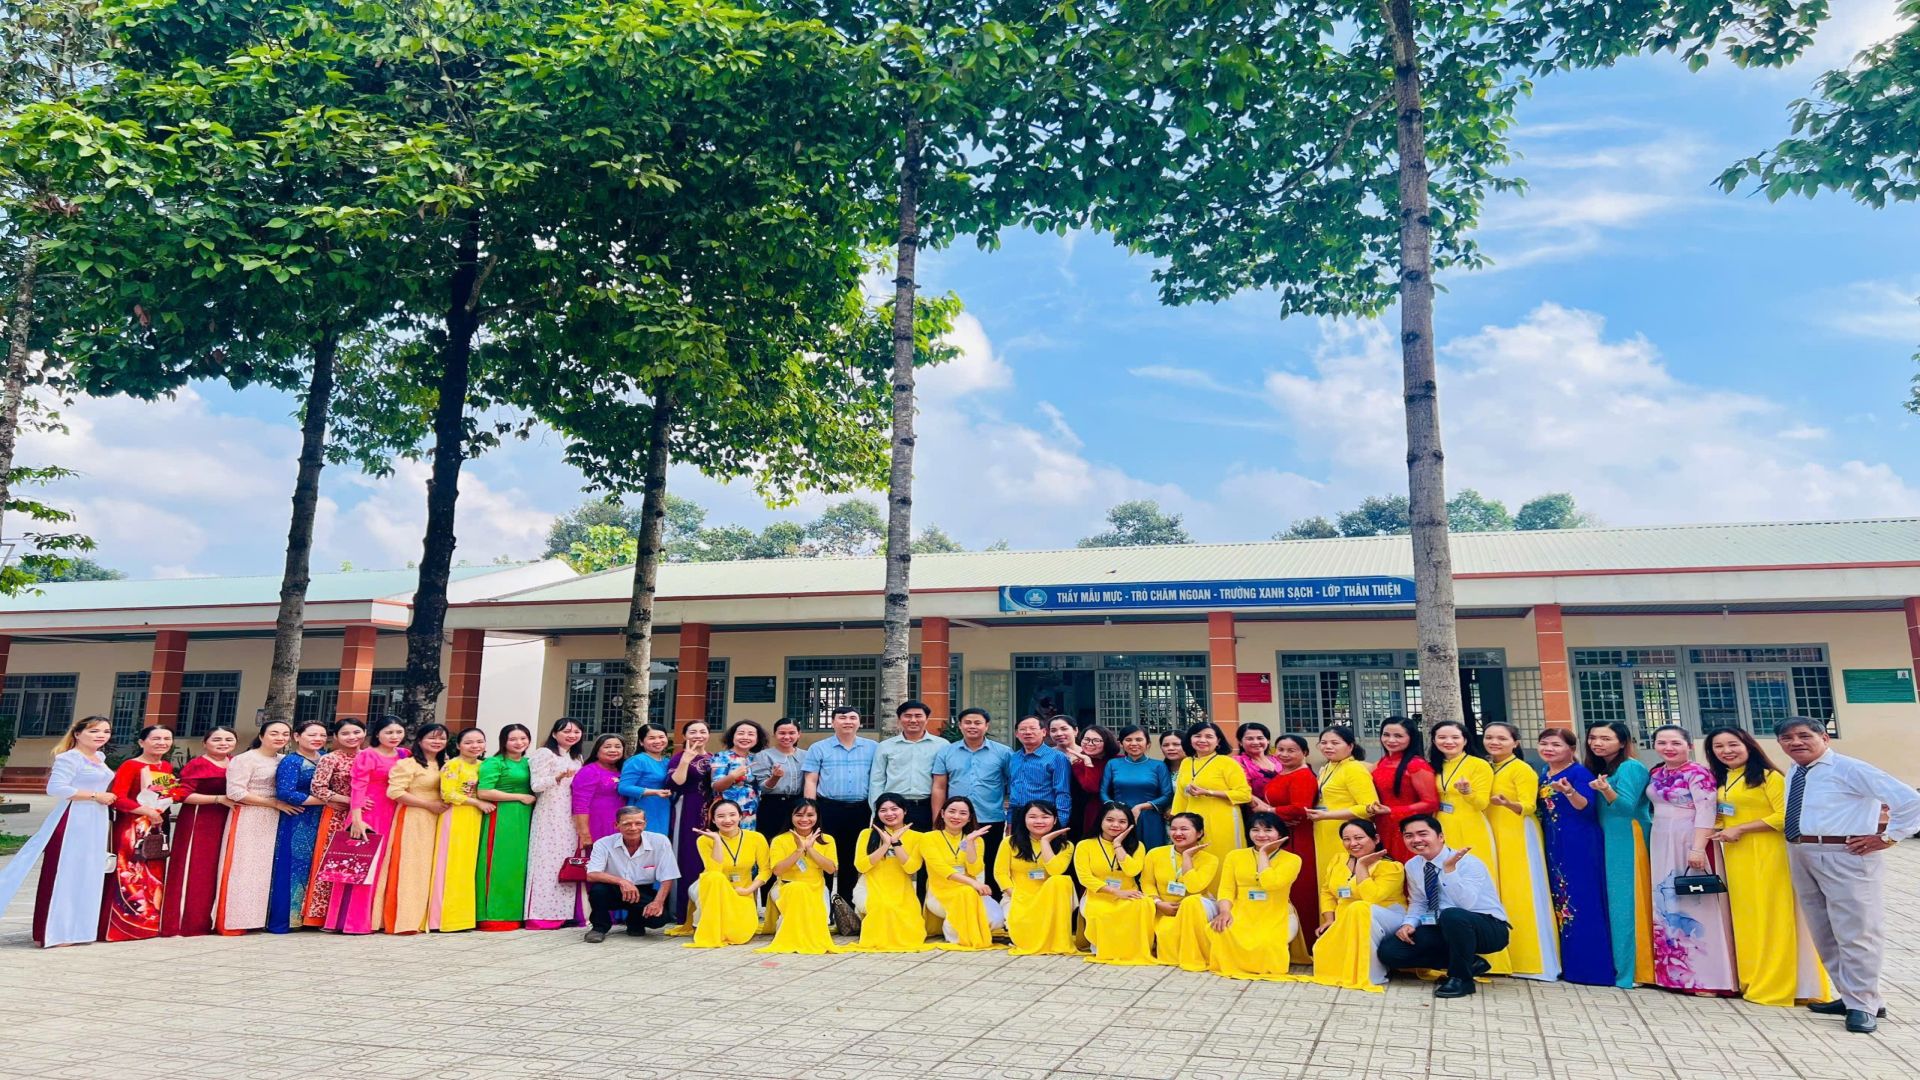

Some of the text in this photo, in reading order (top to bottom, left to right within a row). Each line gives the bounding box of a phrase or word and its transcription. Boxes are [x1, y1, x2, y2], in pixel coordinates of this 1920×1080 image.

[1080, 588, 1101, 603] MẪU
[1102, 590, 1123, 605] MỰC
[1130, 588, 1149, 602] TRÒ
[1150, 587, 1177, 601] CHĂM
[1179, 589, 1211, 601] NGOAN
[1219, 585, 1257, 600] TRƯỜNG
[1258, 587, 1286, 599] XANH
[1287, 586, 1314, 601] SẠCH
[1322, 583, 1342, 598] LỚP
[1342, 582, 1370, 597] THÂN
[1371, 581, 1402, 598] THIỆN
